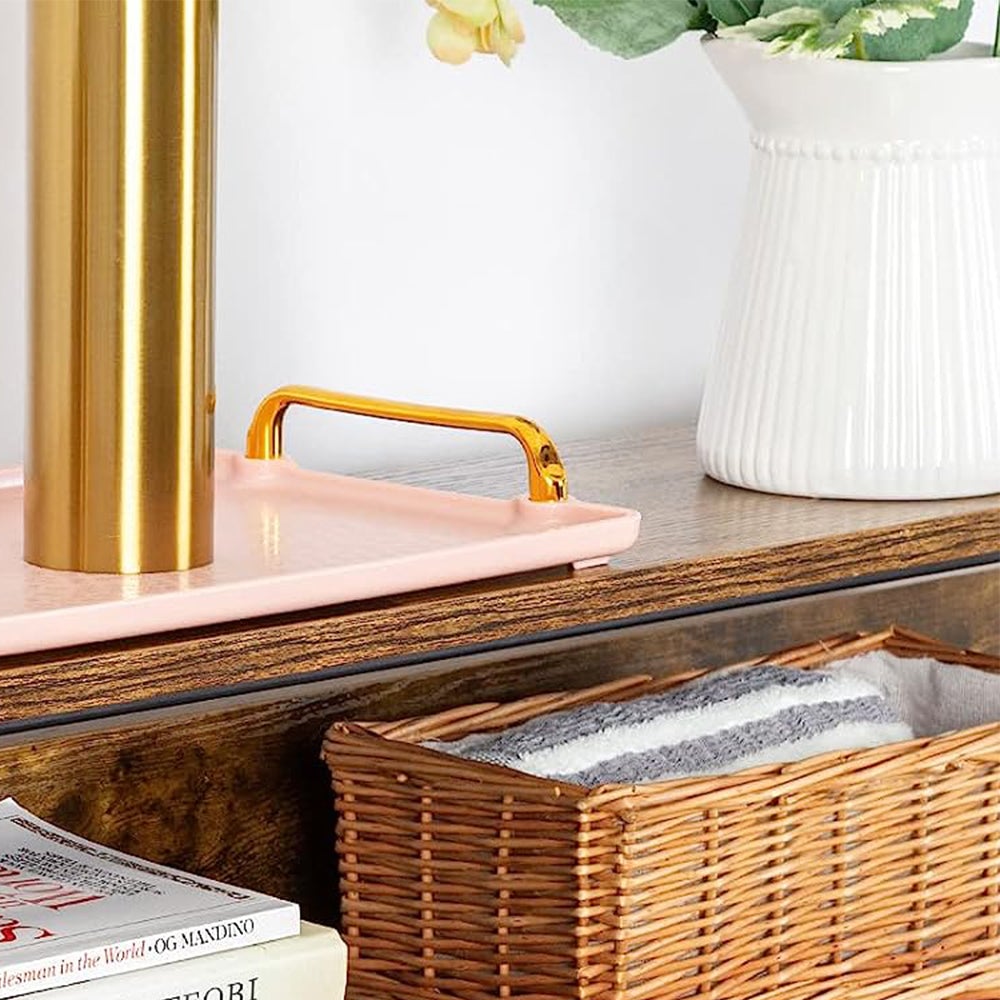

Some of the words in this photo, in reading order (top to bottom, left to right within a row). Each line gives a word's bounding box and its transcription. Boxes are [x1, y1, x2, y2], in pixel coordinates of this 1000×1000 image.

[60, 959, 75, 975] in
[77, 953, 100, 971] the
[103, 940, 146, 965] World
[154, 935, 177, 954] OG
[181, 919, 255, 949] MANDINO
